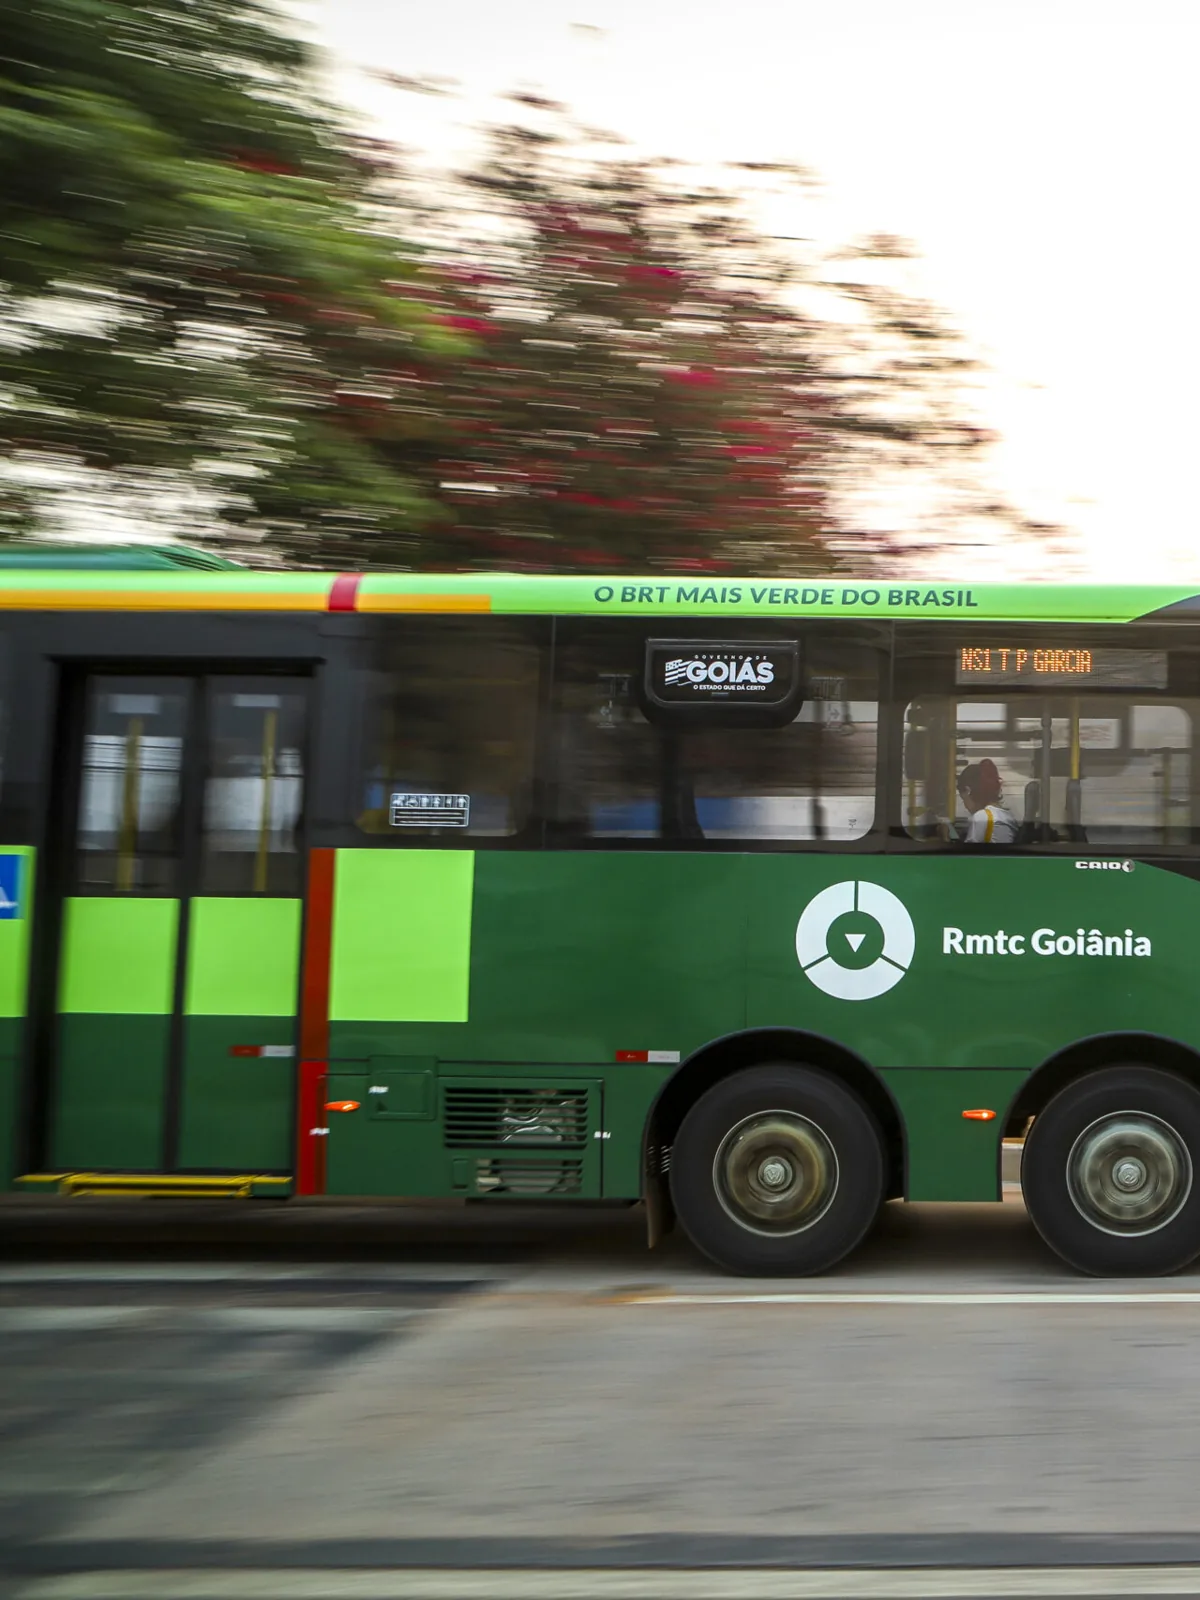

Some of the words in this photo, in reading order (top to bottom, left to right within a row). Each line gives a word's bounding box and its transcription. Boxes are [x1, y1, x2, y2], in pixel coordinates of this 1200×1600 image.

[594, 585, 614, 602] O
[621, 585, 670, 603] BRT
[676, 586, 742, 604] MAIS
[751, 587, 834, 605] VERDE
[841, 588, 880, 606] DO
[888, 589, 978, 607] BRASIL
[685, 656, 775, 684] GOIÁS
[998, 648, 1011, 671] T
[1016, 649, 1028, 672] P
[1033, 649, 1092, 673] GARCIA
[1075, 861, 1121, 870] CAIO
[943, 926, 1026, 956] Rmtc
[1031, 928, 1152, 958] Goiânia
